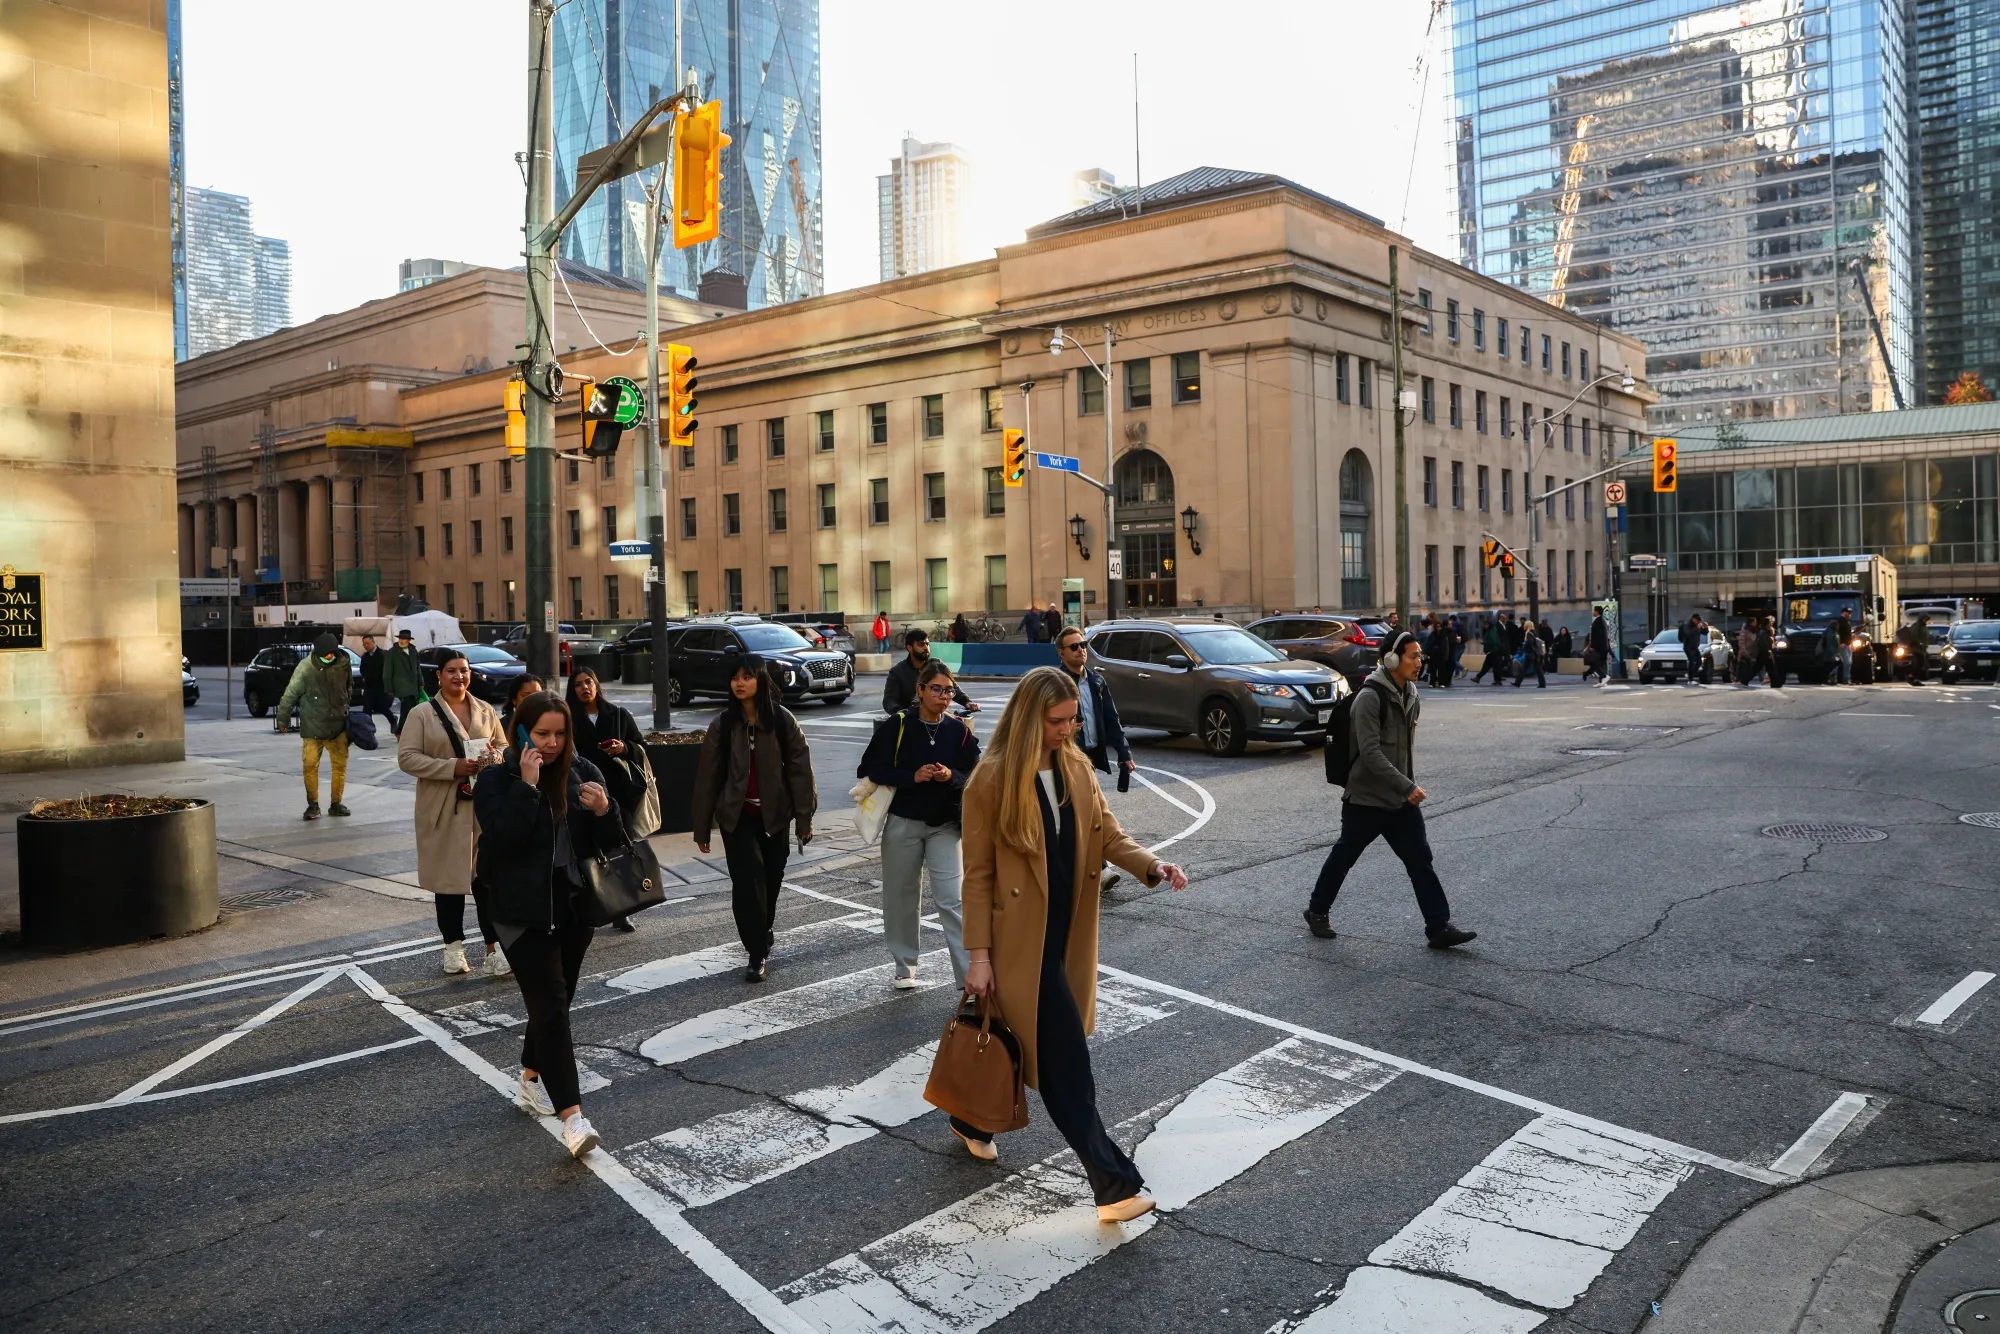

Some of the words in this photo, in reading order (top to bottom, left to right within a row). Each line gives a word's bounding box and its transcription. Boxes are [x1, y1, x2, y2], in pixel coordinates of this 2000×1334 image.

[1143, 307, 1206, 329] OFFICES
[1048, 455, 1062, 467] York
[620, 545, 635, 553] York
[1110, 562, 1121, 575] 40
[1794, 574, 1822, 585] BEER
[1824, 574, 1859, 584] STORE
[0, 592, 36, 605] OYAL
[0, 608, 36, 621] ORK
[0, 624, 37, 637] OTEL
